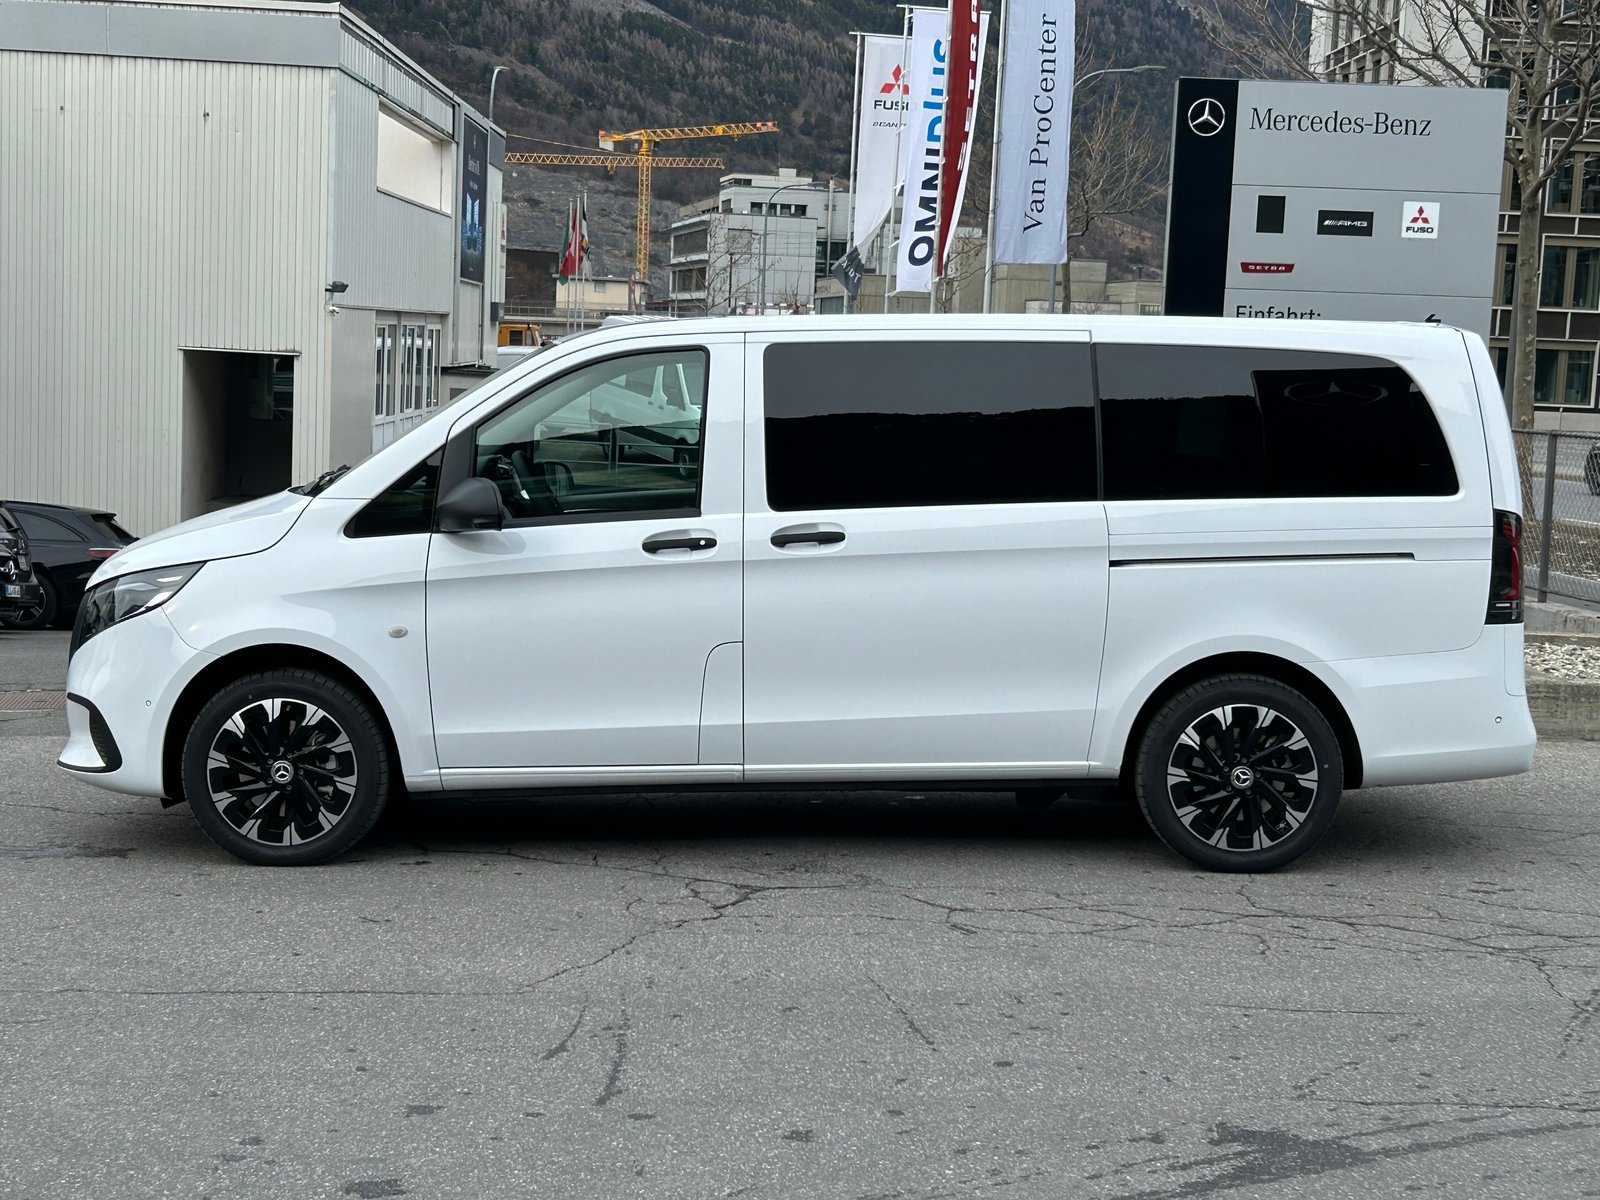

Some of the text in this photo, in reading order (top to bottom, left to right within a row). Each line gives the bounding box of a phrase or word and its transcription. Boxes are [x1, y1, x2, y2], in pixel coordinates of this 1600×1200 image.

[873, 99, 910, 112] FUS
[1023, 13, 1057, 234] Van ProCenter
[1249, 107, 1432, 137] Mercedes-Benz
[1405, 226, 1434, 234] FUSO
